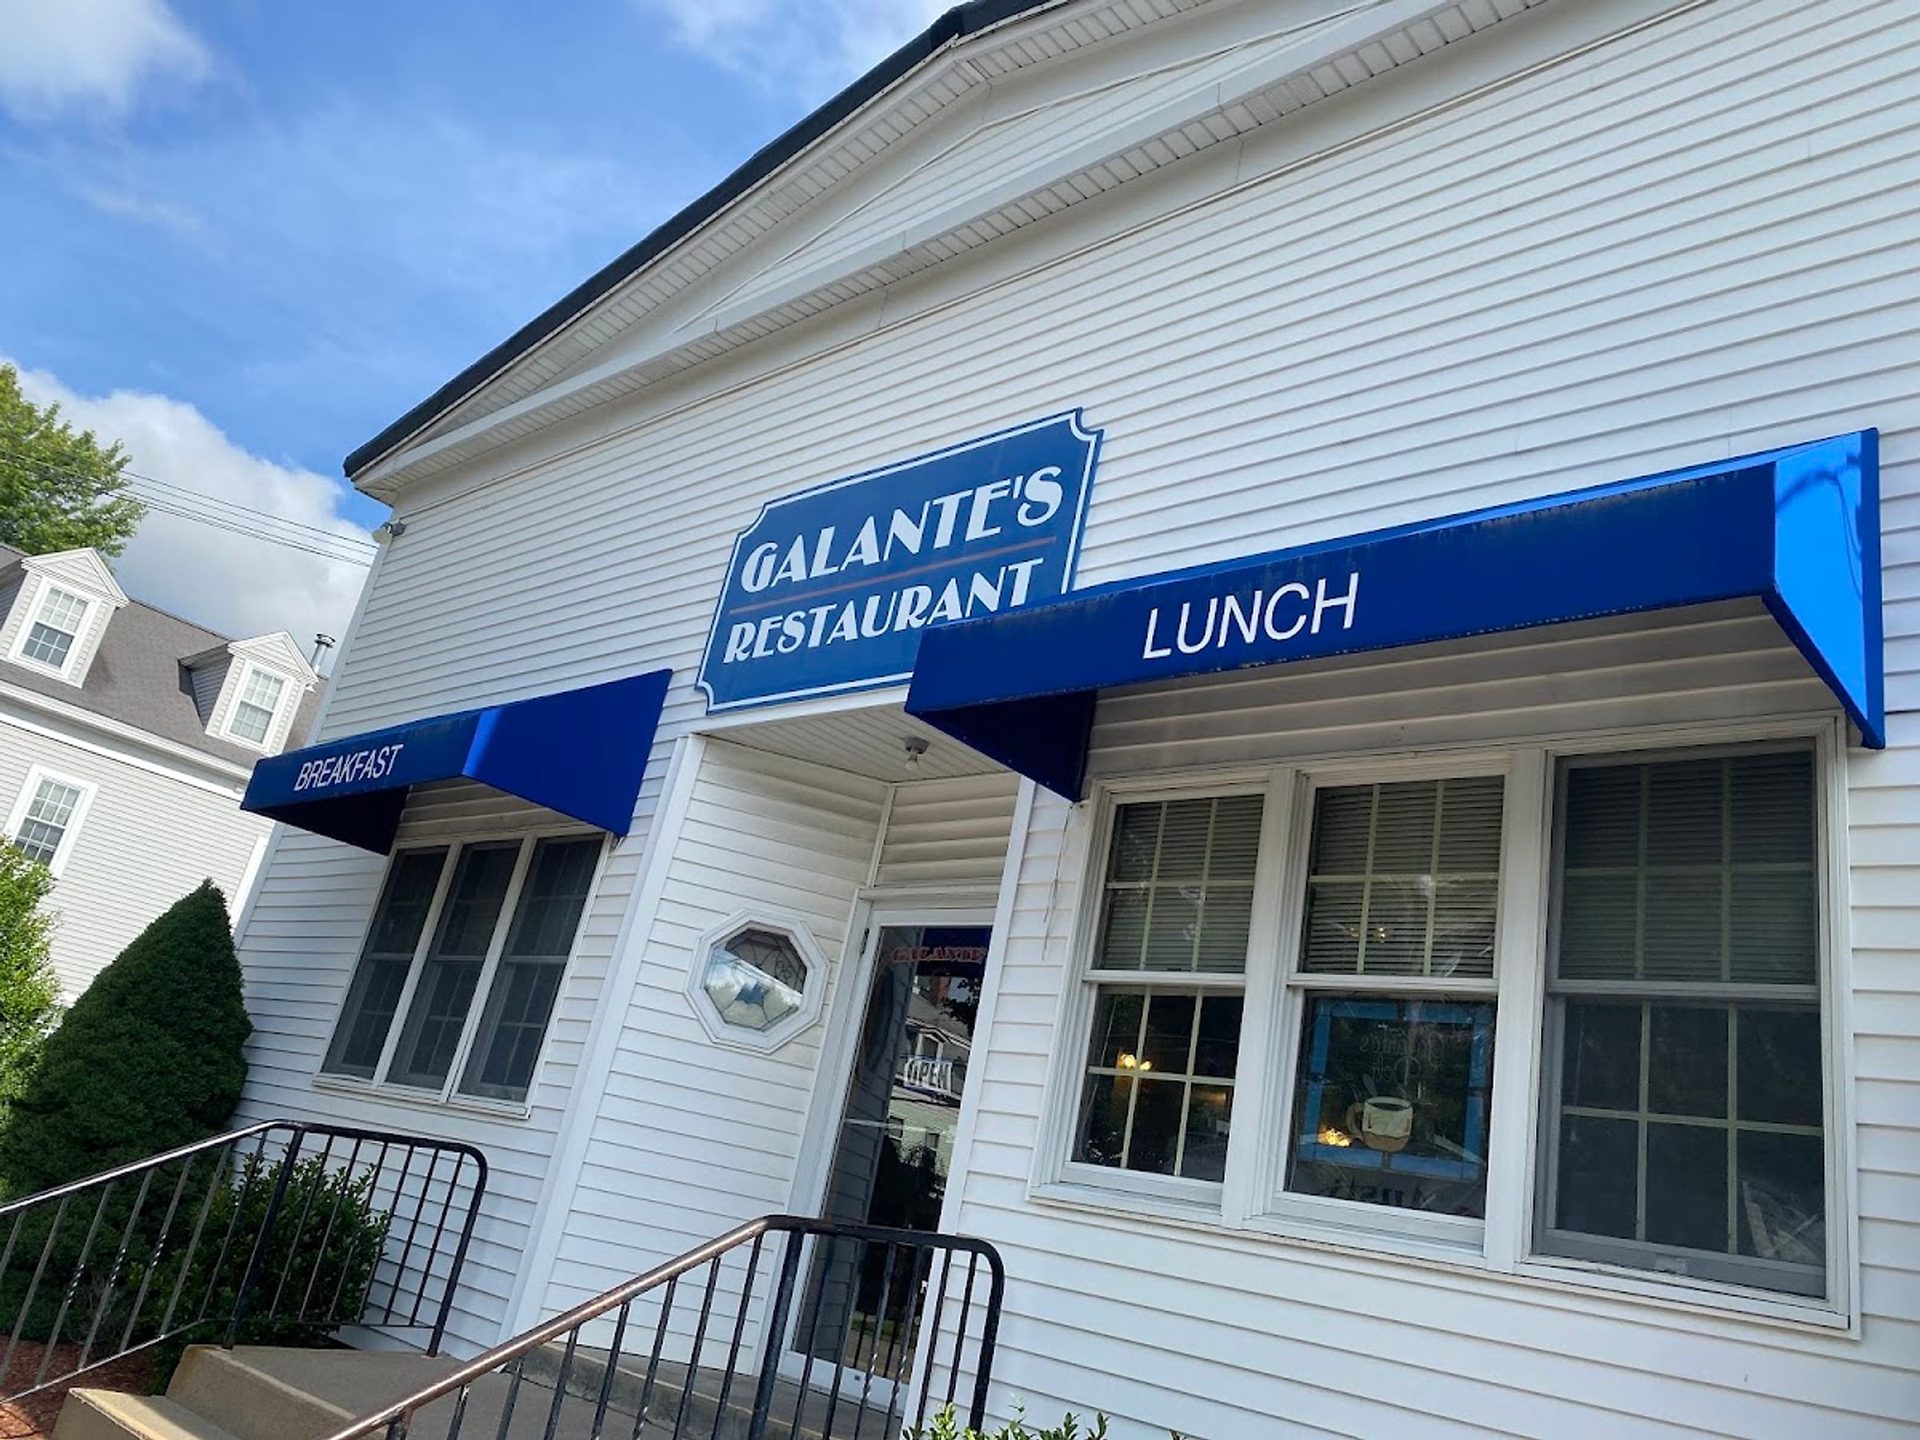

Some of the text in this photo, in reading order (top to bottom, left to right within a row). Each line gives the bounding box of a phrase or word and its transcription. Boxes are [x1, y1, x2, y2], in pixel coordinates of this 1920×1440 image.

[740, 466, 1063, 593] GALANTE'S
[723, 558, 1044, 663] RESTAURANT
[1143, 572, 1359, 660] LUNCH
[293, 744, 404, 791] BREAKFAST
[904, 1057, 953, 1096] OPEN
